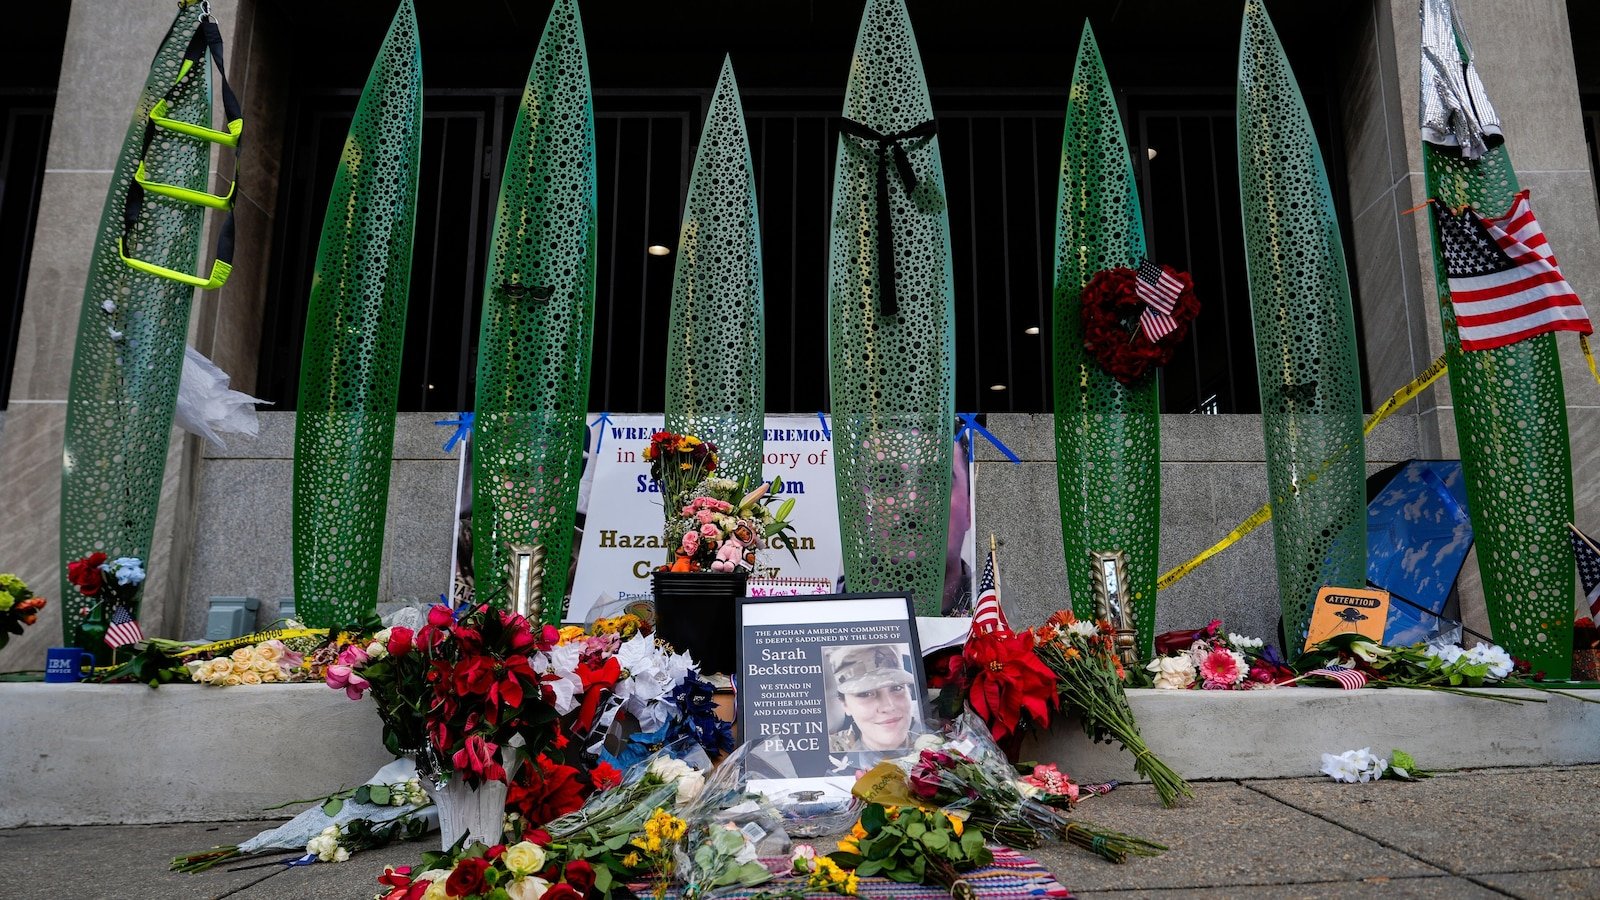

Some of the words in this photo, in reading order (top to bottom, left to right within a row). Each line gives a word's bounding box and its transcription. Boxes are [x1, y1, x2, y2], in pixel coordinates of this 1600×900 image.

[611, 427, 665, 440] WREA
[762, 428, 832, 442] EREMON
[616, 447, 635, 463] in
[807, 449, 828, 465] of
[599, 530, 669, 548] Hazar
[618, 591, 656, 602] Prayin
[1328, 595, 1375, 607] ATTENTION
[807, 627, 849, 635] AMERICAN
[850, 625, 900, 633] COMMUNITY
[795, 635, 837, 643] SADDENED
[761, 647, 807, 661] Sarah
[48, 658, 72, 669] IBM
[748, 663, 822, 676] Beckstrom
[761, 691, 809, 699] SOLIDARITY
[773, 708, 799, 716] LOVED
[800, 707, 822, 715] ONES
[760, 722, 801, 736] REST
[805, 721, 823, 734] IN
[763, 737, 820, 752] PEACE
